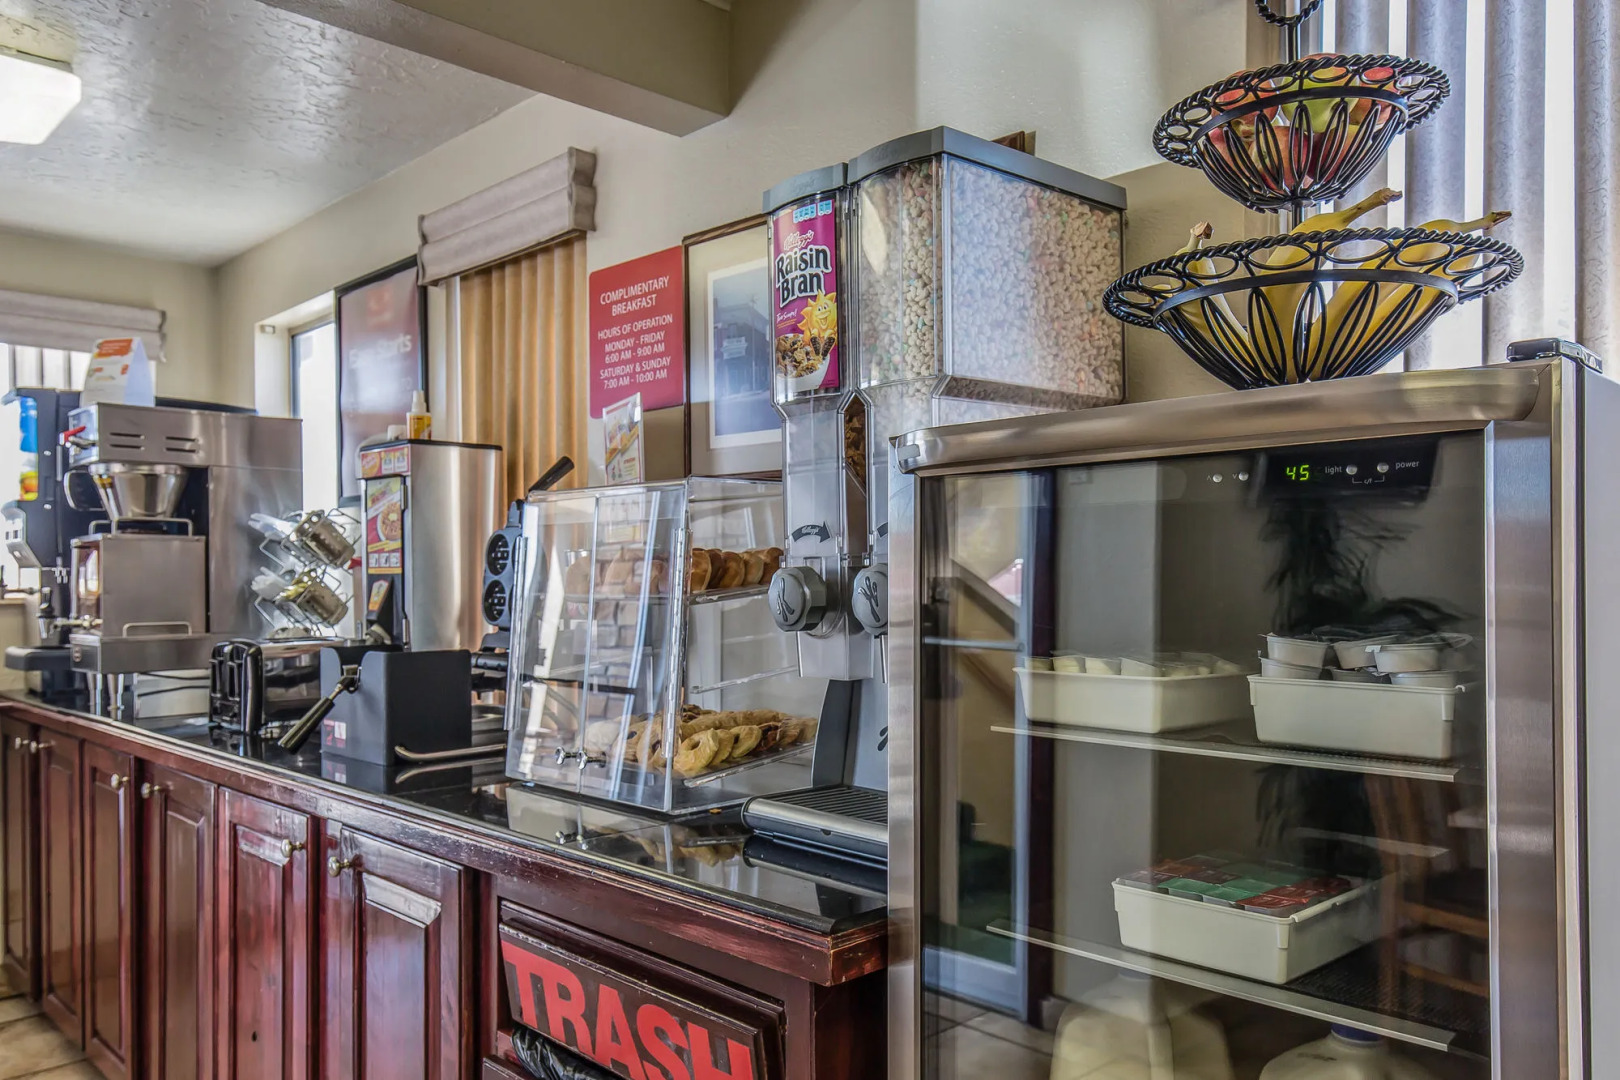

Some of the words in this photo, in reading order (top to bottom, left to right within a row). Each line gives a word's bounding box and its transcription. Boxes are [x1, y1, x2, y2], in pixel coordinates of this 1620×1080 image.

[776, 246, 832, 288] Raisin
[600, 276, 670, 305] COMPLIMENTARY
[780, 271, 825, 307] Bran
[612, 294, 657, 316] BREAKFAST
[598, 326, 621, 340] HOURS
[622, 323, 632, 335] OF
[632, 314, 673, 332] OPERATION
[605, 337, 635, 353] MONDAY
[640, 331, 665, 345] FRIDAY
[605, 352, 619, 364] 6:00
[620, 349, 632, 361] AM
[637, 346, 652, 358] 9:00
[653, 342, 665, 354] AM
[600, 364, 634, 379] SATURDAY
[635, 362, 641, 372] &
[641, 356, 671, 371] SUNDAY
[604, 378, 618, 390] 7:00
[619, 375, 630, 387] AM
[636, 372, 654, 384] 10:00
[655, 369, 667, 381] AM
[1286, 464, 1309, 481] 45
[1325, 466, 1342, 475] light
[1395, 461, 1420, 470] power
[501, 940, 753, 1080] TRASH
